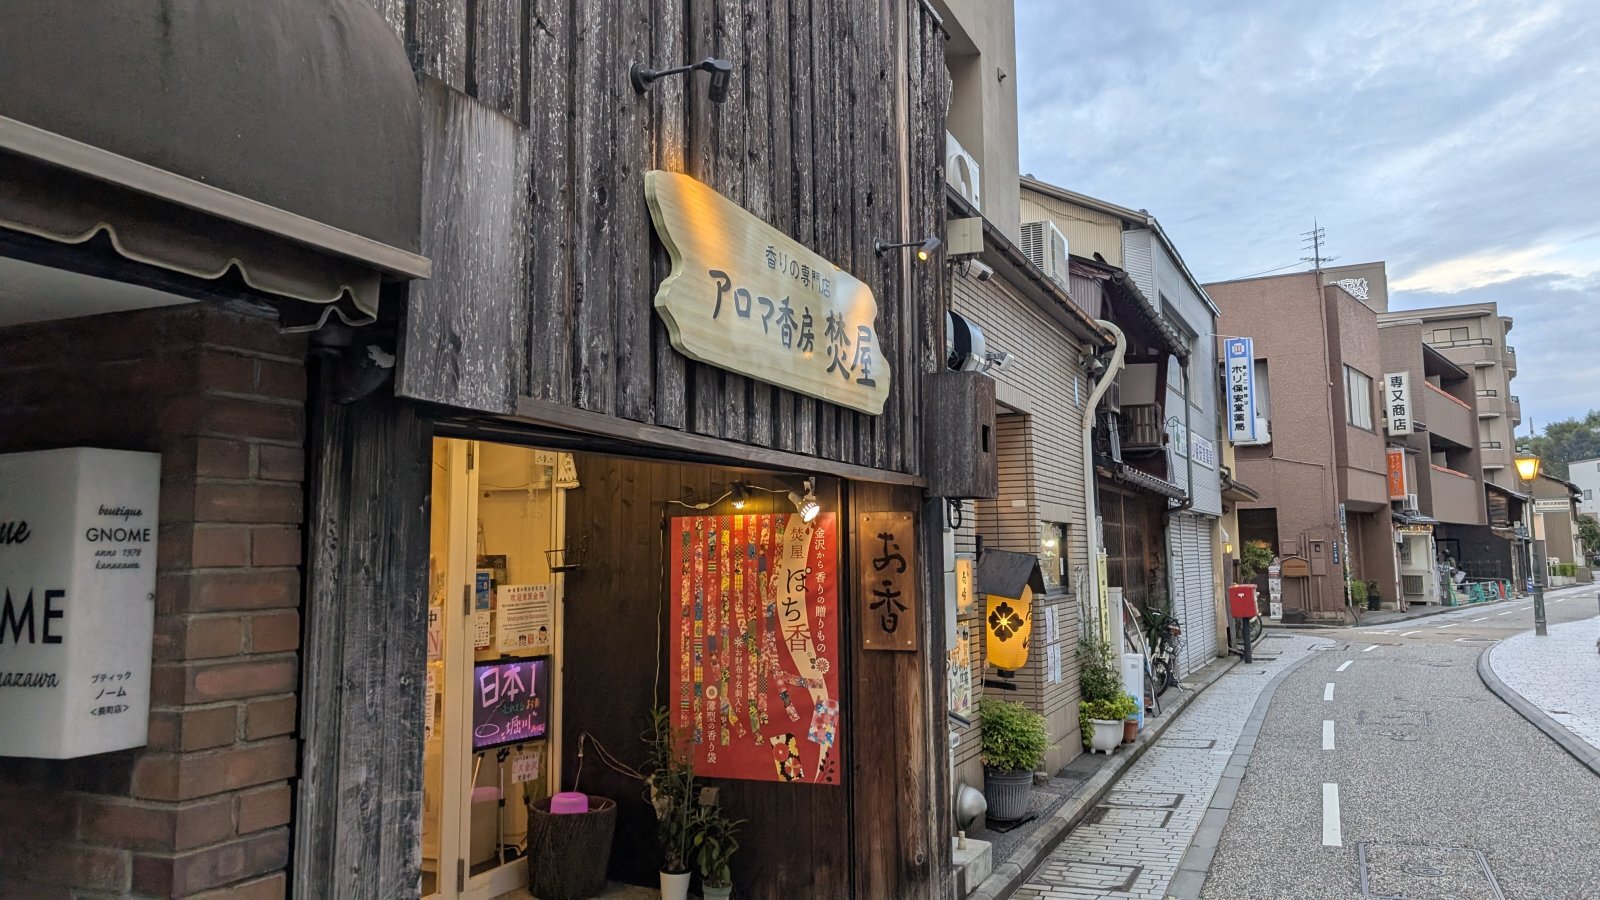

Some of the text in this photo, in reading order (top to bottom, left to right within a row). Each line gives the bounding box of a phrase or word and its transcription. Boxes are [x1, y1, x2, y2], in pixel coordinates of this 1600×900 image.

[765, 245, 831, 298] 香りの専門店
[708, 269, 876, 388] アロマ香房 焚屋
[1231, 365, 1246, 432] ホリ保安堂薬局
[1390, 375, 1407, 431] 専又商店
[86, 527, 152, 542] GNOME
[98, 504, 143, 521] boutique
[95, 560, 140, 569] kanazawa
[781, 526, 813, 653] 焚屋 ぽち香
[814, 526, 827, 653] 金沢から香りの贈りもの
[869, 531, 909, 634] お香
[91, 671, 132, 684] ブティック
[95, 686, 127, 700] ノーム
[706, 700, 717, 764] 薄型の香り袋
